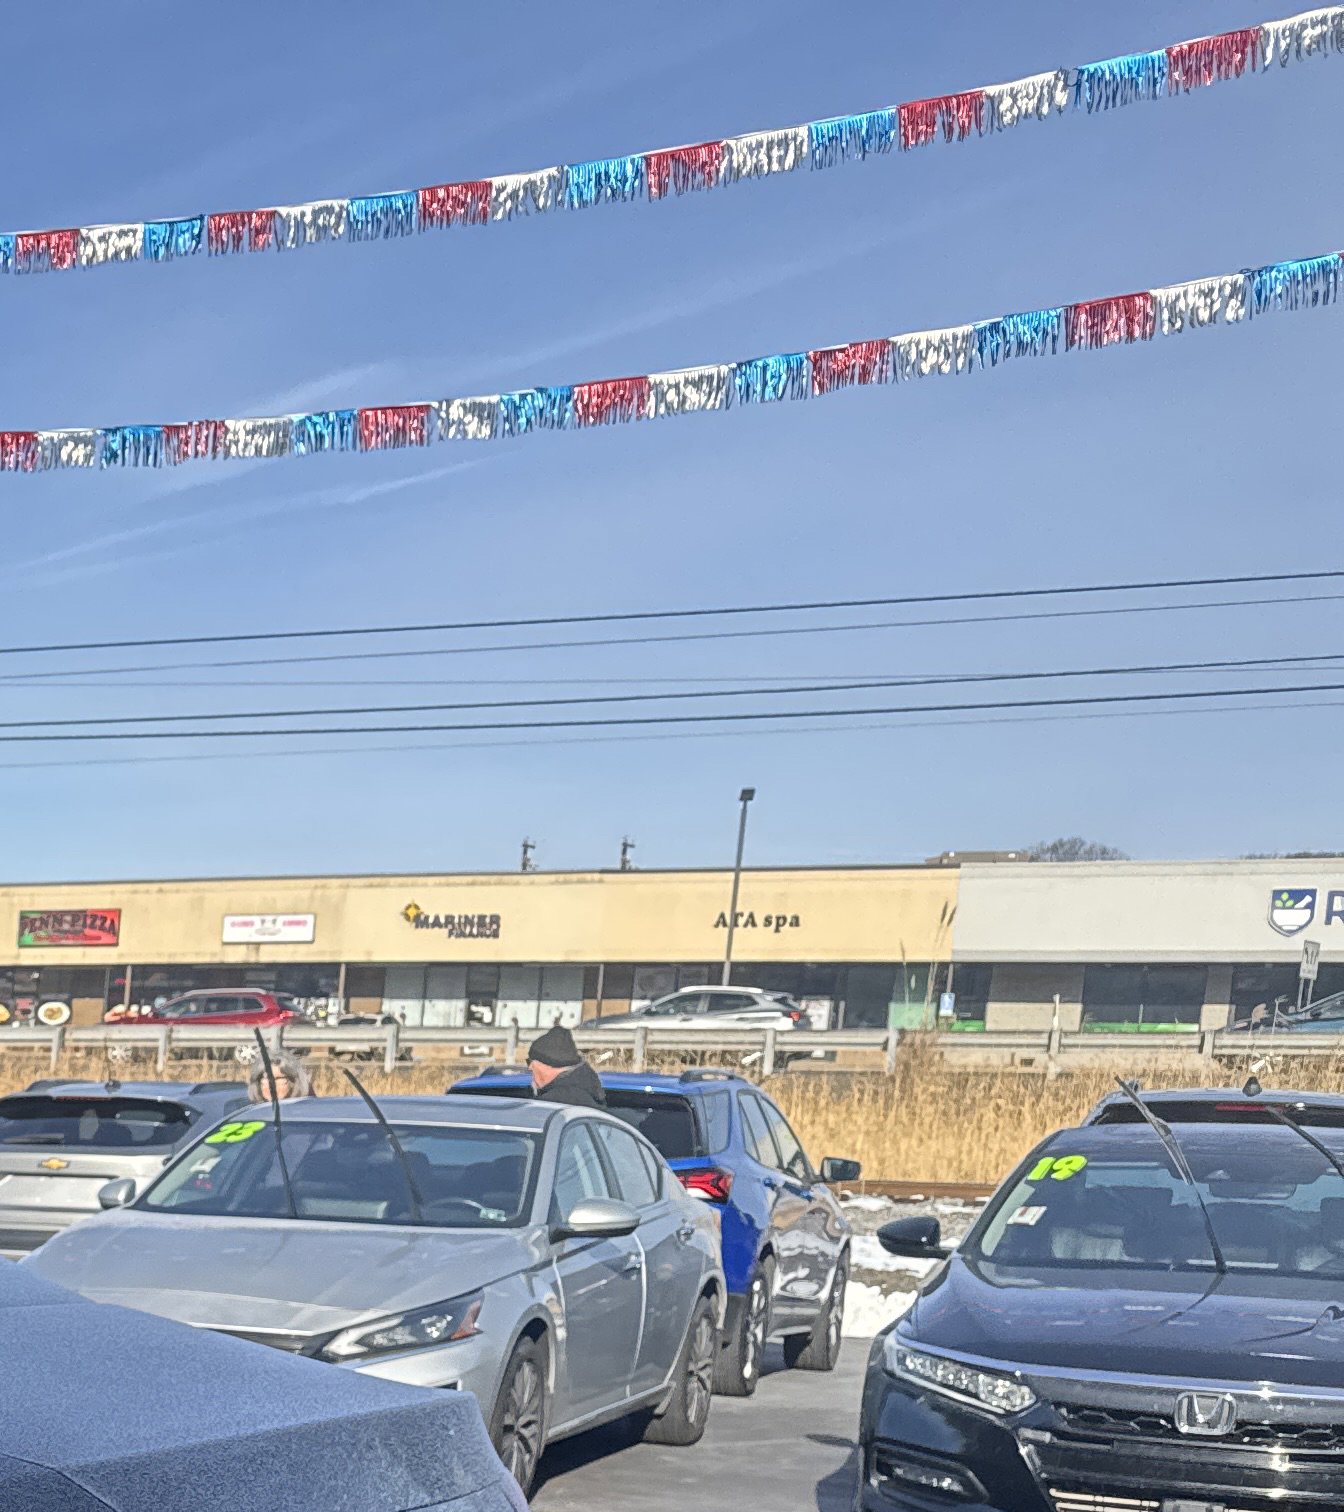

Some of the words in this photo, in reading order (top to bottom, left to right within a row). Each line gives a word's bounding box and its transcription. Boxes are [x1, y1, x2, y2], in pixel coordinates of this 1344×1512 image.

[414, 913, 501, 929] MARINER
[763, 914, 800, 933] spa
[447, 928, 500, 939] FINANCE
[204, 1120, 267, 1144] 23
[1026, 1154, 1088, 1180] 19
